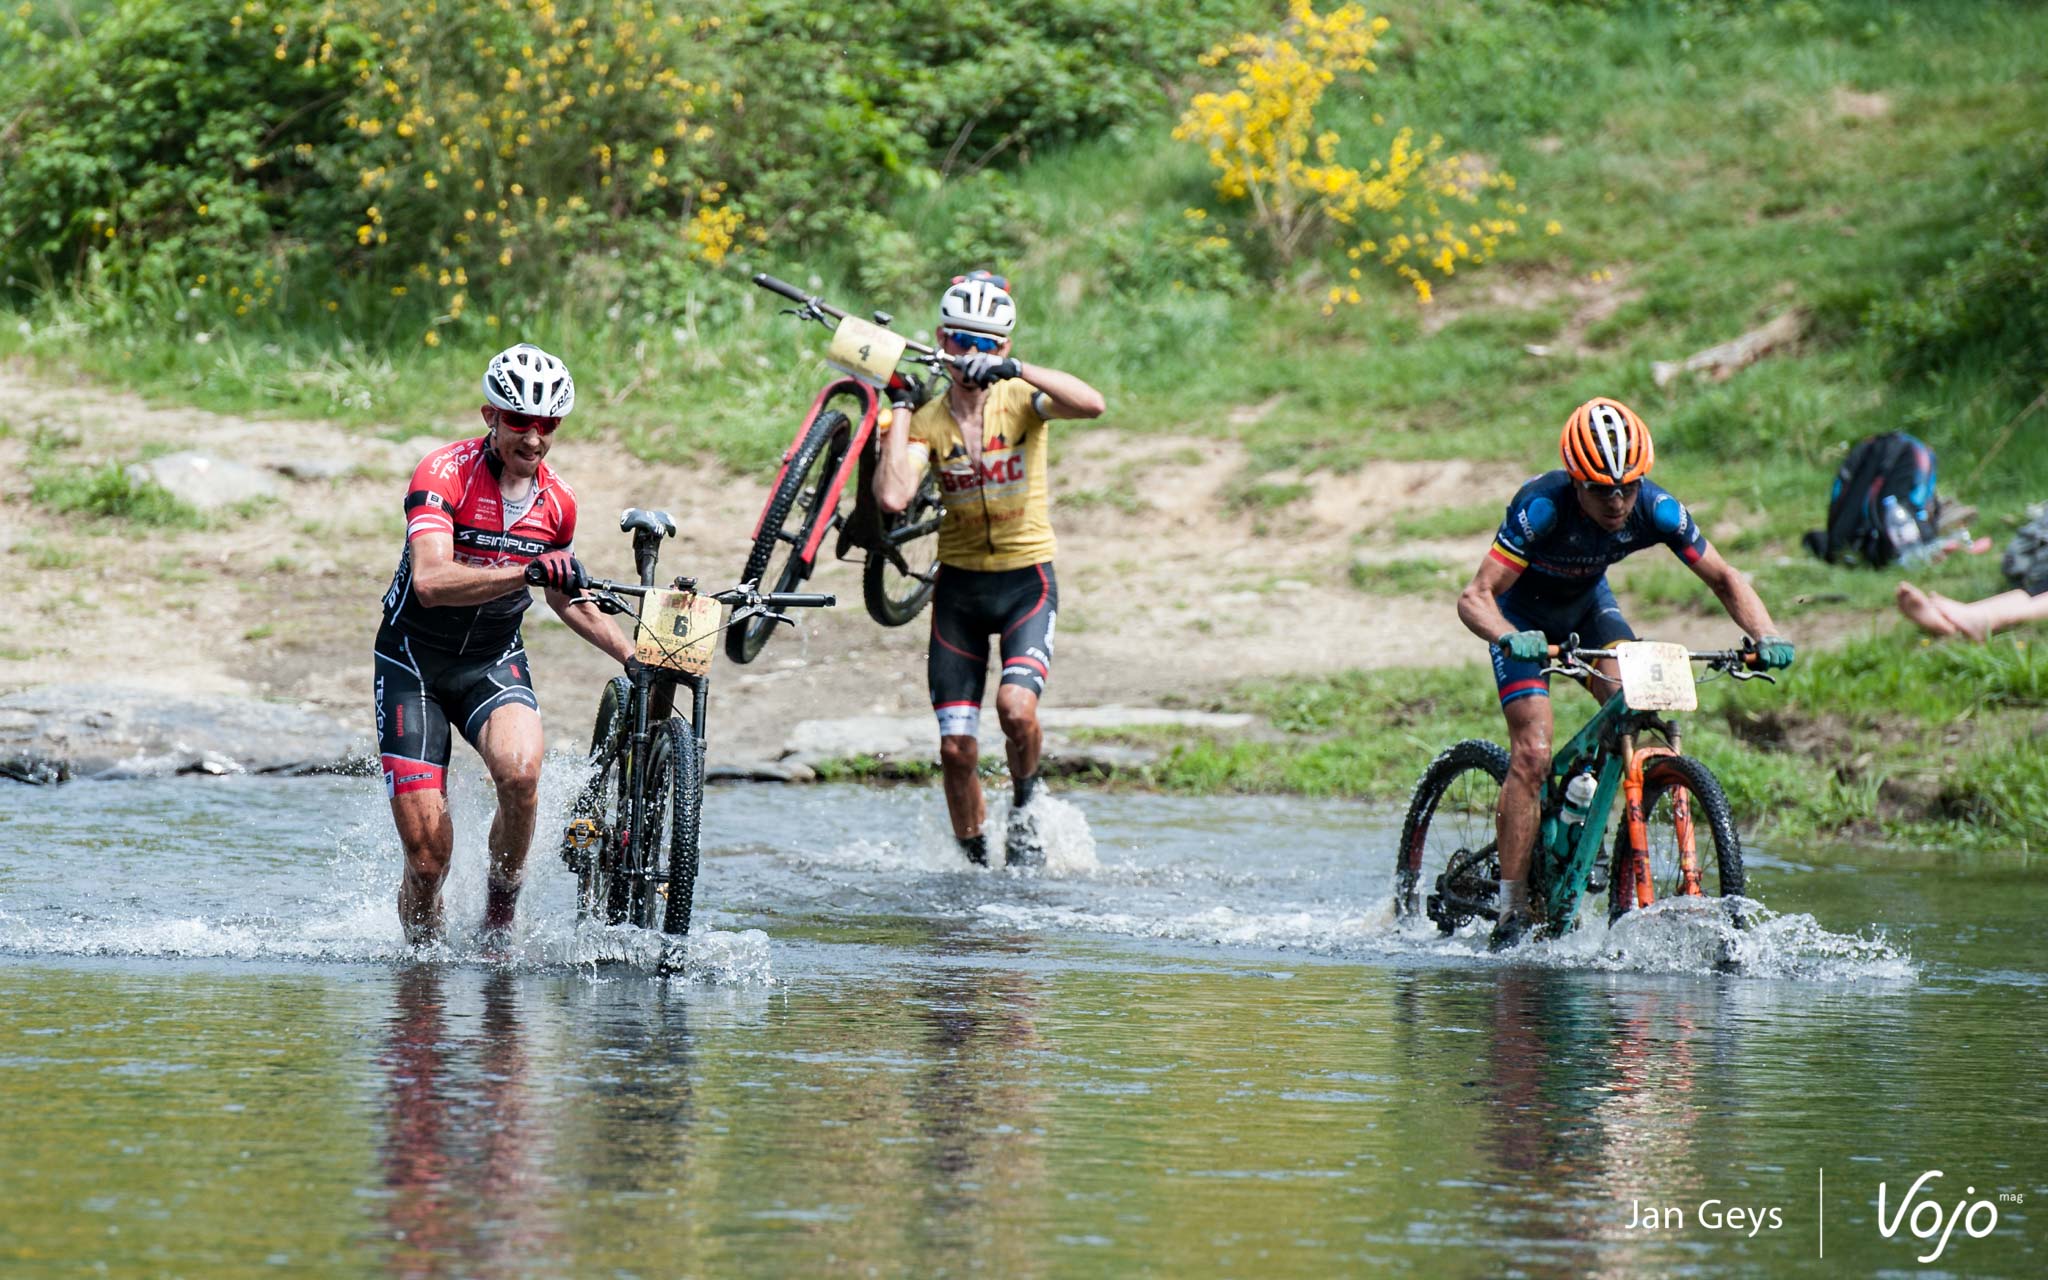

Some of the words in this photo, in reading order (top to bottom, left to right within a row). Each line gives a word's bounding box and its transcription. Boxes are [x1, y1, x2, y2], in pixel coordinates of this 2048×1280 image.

[858, 344, 872, 362] 4
[475, 533, 545, 554] SIMPLON
[673, 614, 689, 638] 6
[376, 675, 387, 744] TEXPA
